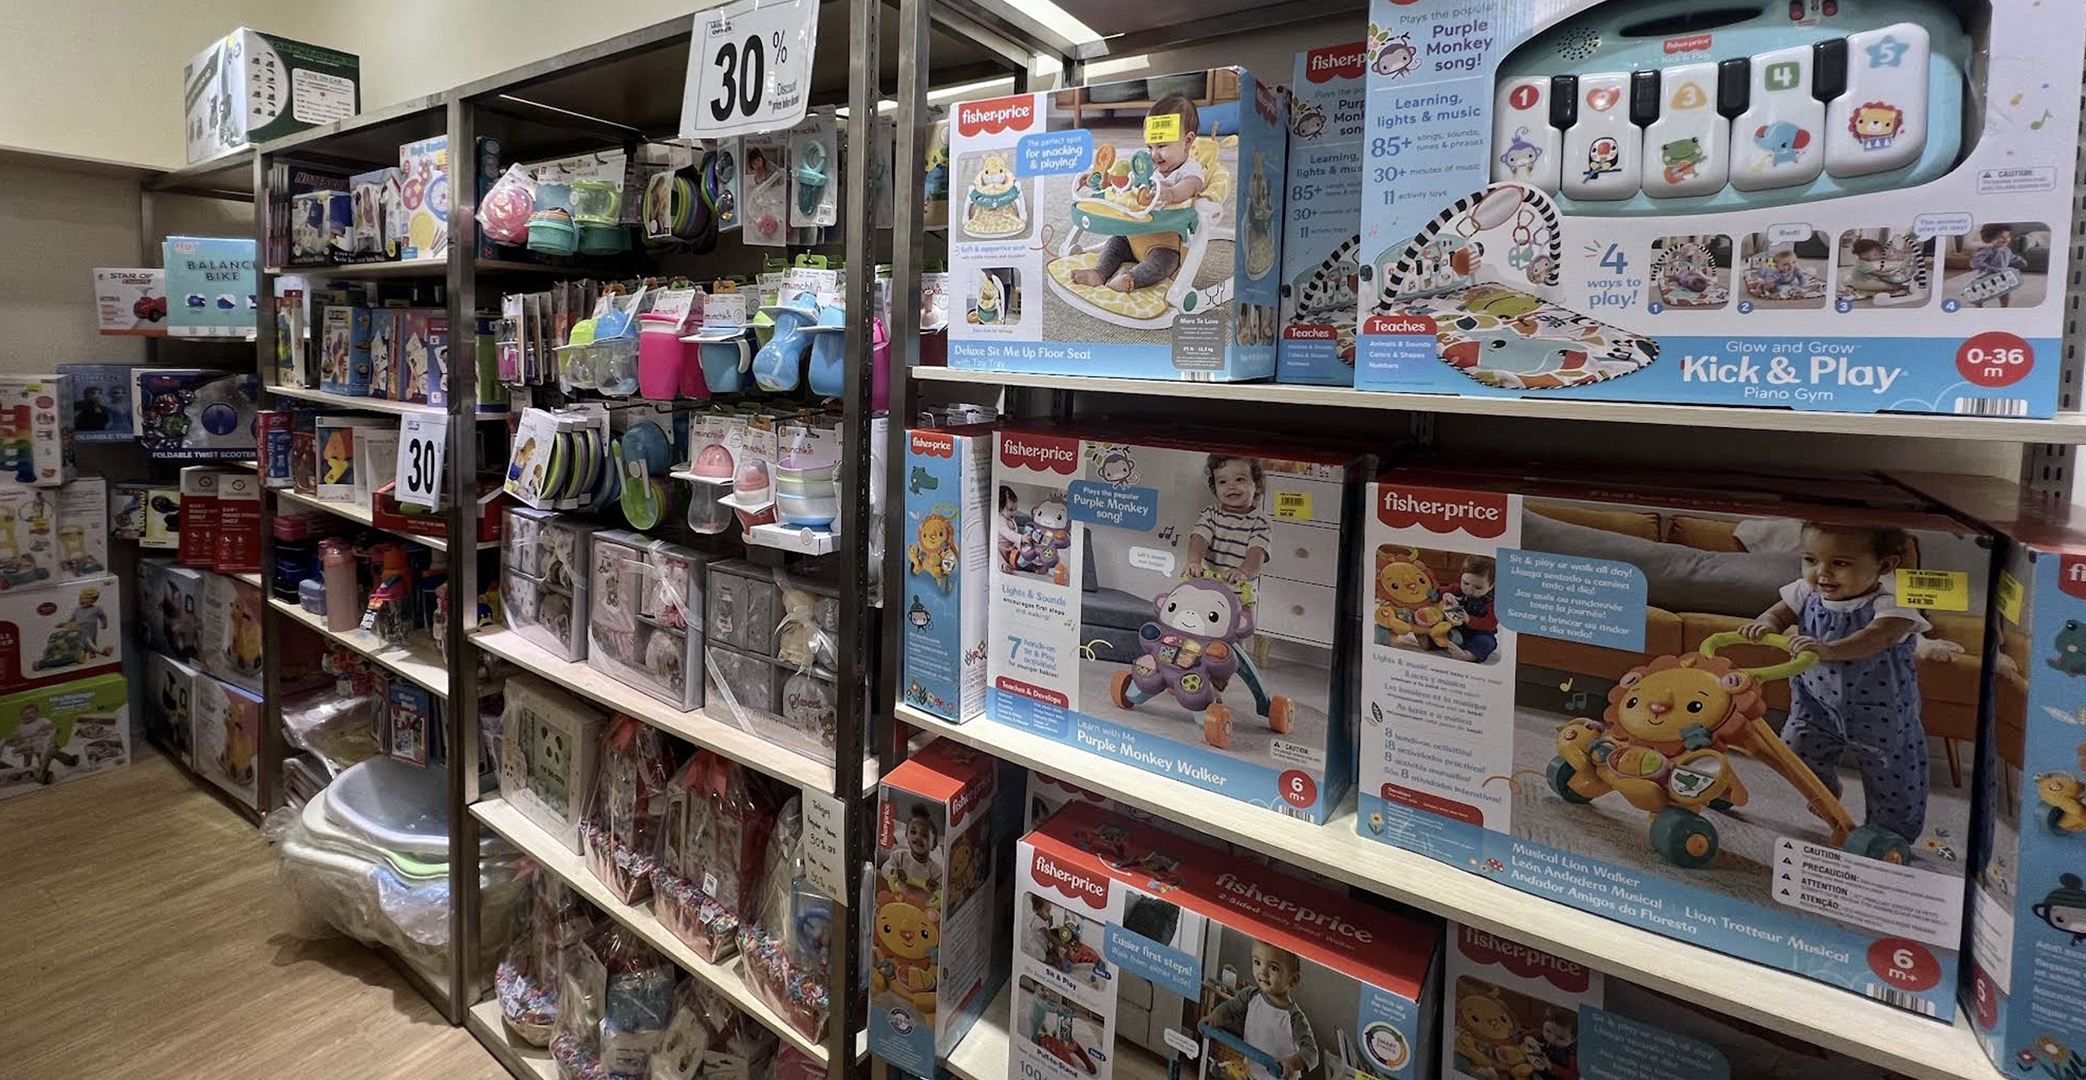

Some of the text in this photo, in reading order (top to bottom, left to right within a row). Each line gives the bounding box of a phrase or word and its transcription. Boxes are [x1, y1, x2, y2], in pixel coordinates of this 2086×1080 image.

[1400, 14, 1427, 24] Plays
[1431, 10, 1449, 19] the
[1432, 20, 1488, 38] Purple
[1426, 37, 1493, 55] Monkey
[1879, 44, 1894, 65] 5
[1435, 53, 1482, 72] song!
[711, 30, 787, 121] 30 %
[1773, 65, 1791, 87] 4
[1395, 95, 1463, 110] Learning,
[1519, 87, 1528, 105] 1
[1683, 87, 1695, 105] 3
[962, 105, 1029, 124] fisher-price
[1378, 106, 1481, 129] lights & music
[1027, 139, 1040, 147] The
[1041, 137, 1065, 148] perfect
[1371, 137, 1412, 158] 85+
[1026, 145, 1083, 159] for snacking
[1030, 156, 1078, 170] & playing!
[1374, 166, 1407, 183] 30+
[1410, 167, 1442, 176] minutes
[1456, 163, 1480, 171] music
[1292, 185, 1322, 201] 85+
[1383, 190, 1395, 205] 11
[1293, 208, 1318, 221] 30+
[1600, 243, 1628, 274] 4
[206, 272, 240, 281] BIKE
[1587, 279, 1641, 290] ways to
[1589, 290, 1638, 309] play!
[1653, 304, 1658, 312] 1
[1742, 303, 1749, 311] 2
[1841, 303, 1848, 311] 3
[1946, 301, 1956, 310] 4
[1290, 327, 1329, 338] Teaches
[1374, 320, 1425, 332] Teaches
[955, 345, 1091, 360] Deluxe Sit Me Up Floor Seat
[1726, 341, 1855, 354] Glow and Grow
[1967, 349, 2025, 365] 0-36
[1683, 356, 1902, 394] Kick & Play
[1984, 366, 2003, 378] m
[1744, 387, 1833, 403] Piano Gym
[912, 437, 951, 450] fisher-price
[1004, 439, 1074, 461] fisher-price
[152, 451, 257, 459] FOLDABLE TWIST SCOOTER
[408, 438, 435, 494] 30
[1083, 487, 1139, 501] Plays the popular
[1074, 495, 1149, 517] Purple Monkey
[1384, 491, 1499, 521] fisher-price
[1096, 510, 1123, 523] song!
[1509, 553, 1633, 578] Sit & play or walk all day!
[1001, 584, 1066, 606] Lights & Sounds
[1542, 581, 1564, 591] todo
[1566, 584, 1575, 593] el
[1507, 609, 1538, 621] Sentar
[1548, 615, 1583, 628] brincar
[1584, 622, 1597, 630] ou
[1599, 623, 1630, 635] andar
[1008, 635, 1022, 659] 7
[1001, 680, 1062, 705] Teaches & Develops
[1077, 719, 1136, 743] Learn with Me
[1077, 731, 1227, 787] Purple Monkey Walker
[1291, 777, 1303, 793] 6
[1289, 792, 1305, 802] m+
[1803, 846, 1841, 861] CAUTION:
[1512, 844, 1640, 888] Musical Lion Walker
[1035, 857, 1104, 897] fisher-price
[1511, 855, 1663, 910] León Andadera Musical
[1801, 878, 1848, 896] ATTENTION
[1216, 873, 1373, 944] fisher-price
[1511, 869, 1697, 935] Andador Amigos da Floresta
[1685, 906, 1849, 965] Lion Trotteur Musical
[1112, 931, 1193, 977] Easier first steps!
[1893, 948, 1915, 969] 6
[1045, 967, 1077, 991] Sit & Play
[1888, 969, 1919, 983] m+
